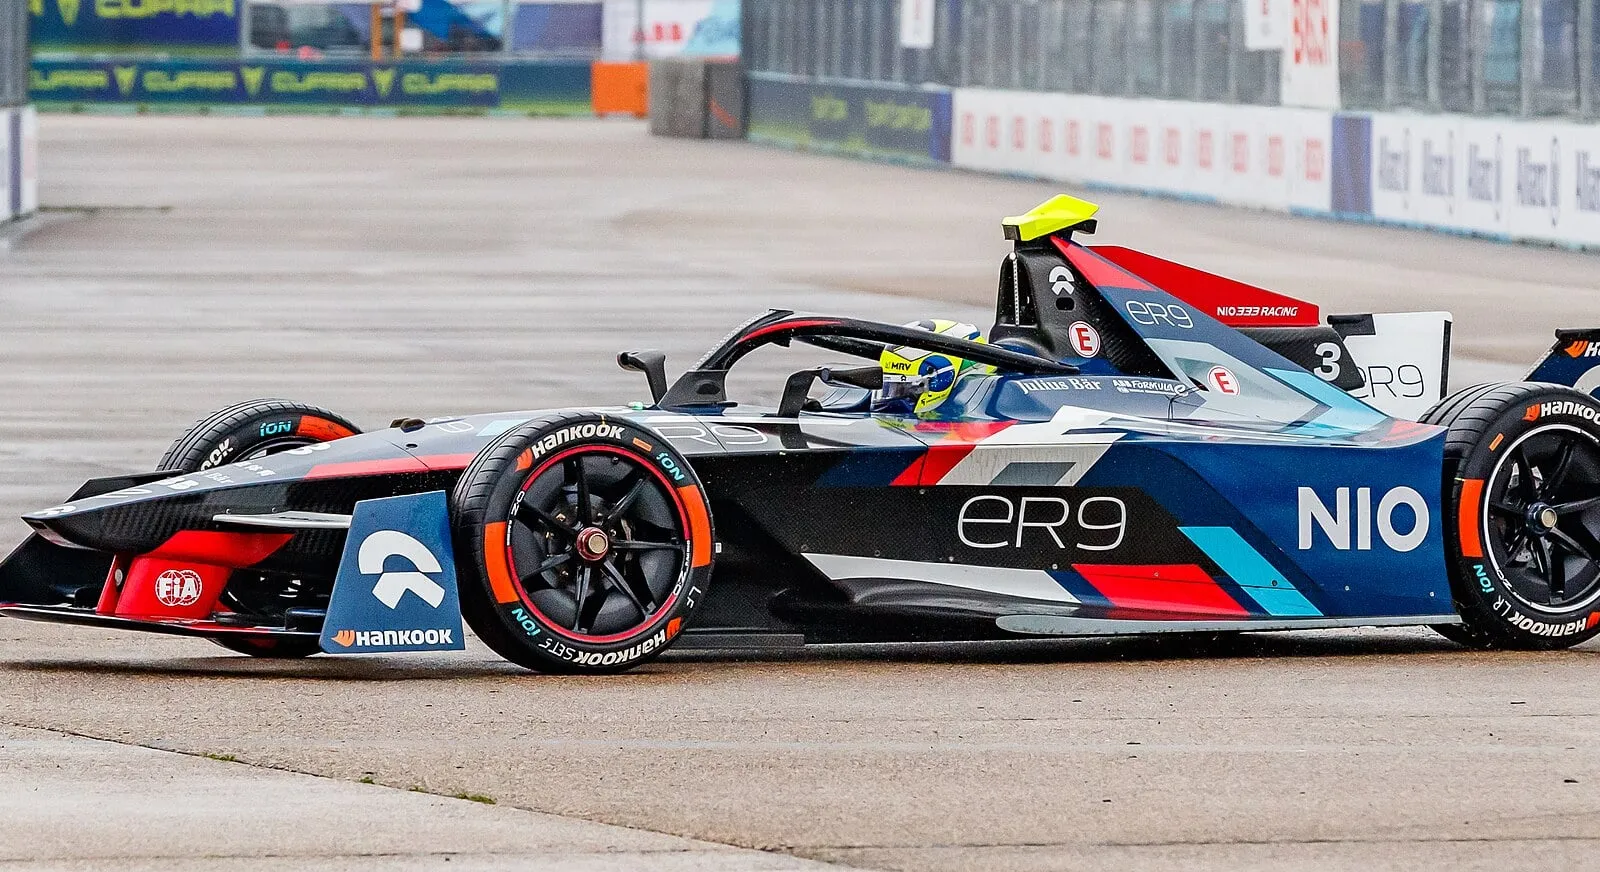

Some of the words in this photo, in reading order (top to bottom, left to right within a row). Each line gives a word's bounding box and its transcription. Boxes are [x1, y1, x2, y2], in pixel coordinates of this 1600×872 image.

[1260, 306, 1299, 317] RACING
[1076, 327, 1092, 352] E
[891, 361, 912, 371] MRV
[1313, 342, 1342, 382] 3
[1016, 378, 1068, 395] Julius
[1070, 377, 1102, 390] Bär
[1131, 380, 1175, 392] FORMULA
[1213, 372, 1235, 394] E
[1298, 486, 1430, 552] NIO
[687, 585, 702, 609] LF
[1492, 595, 1512, 617] LR
